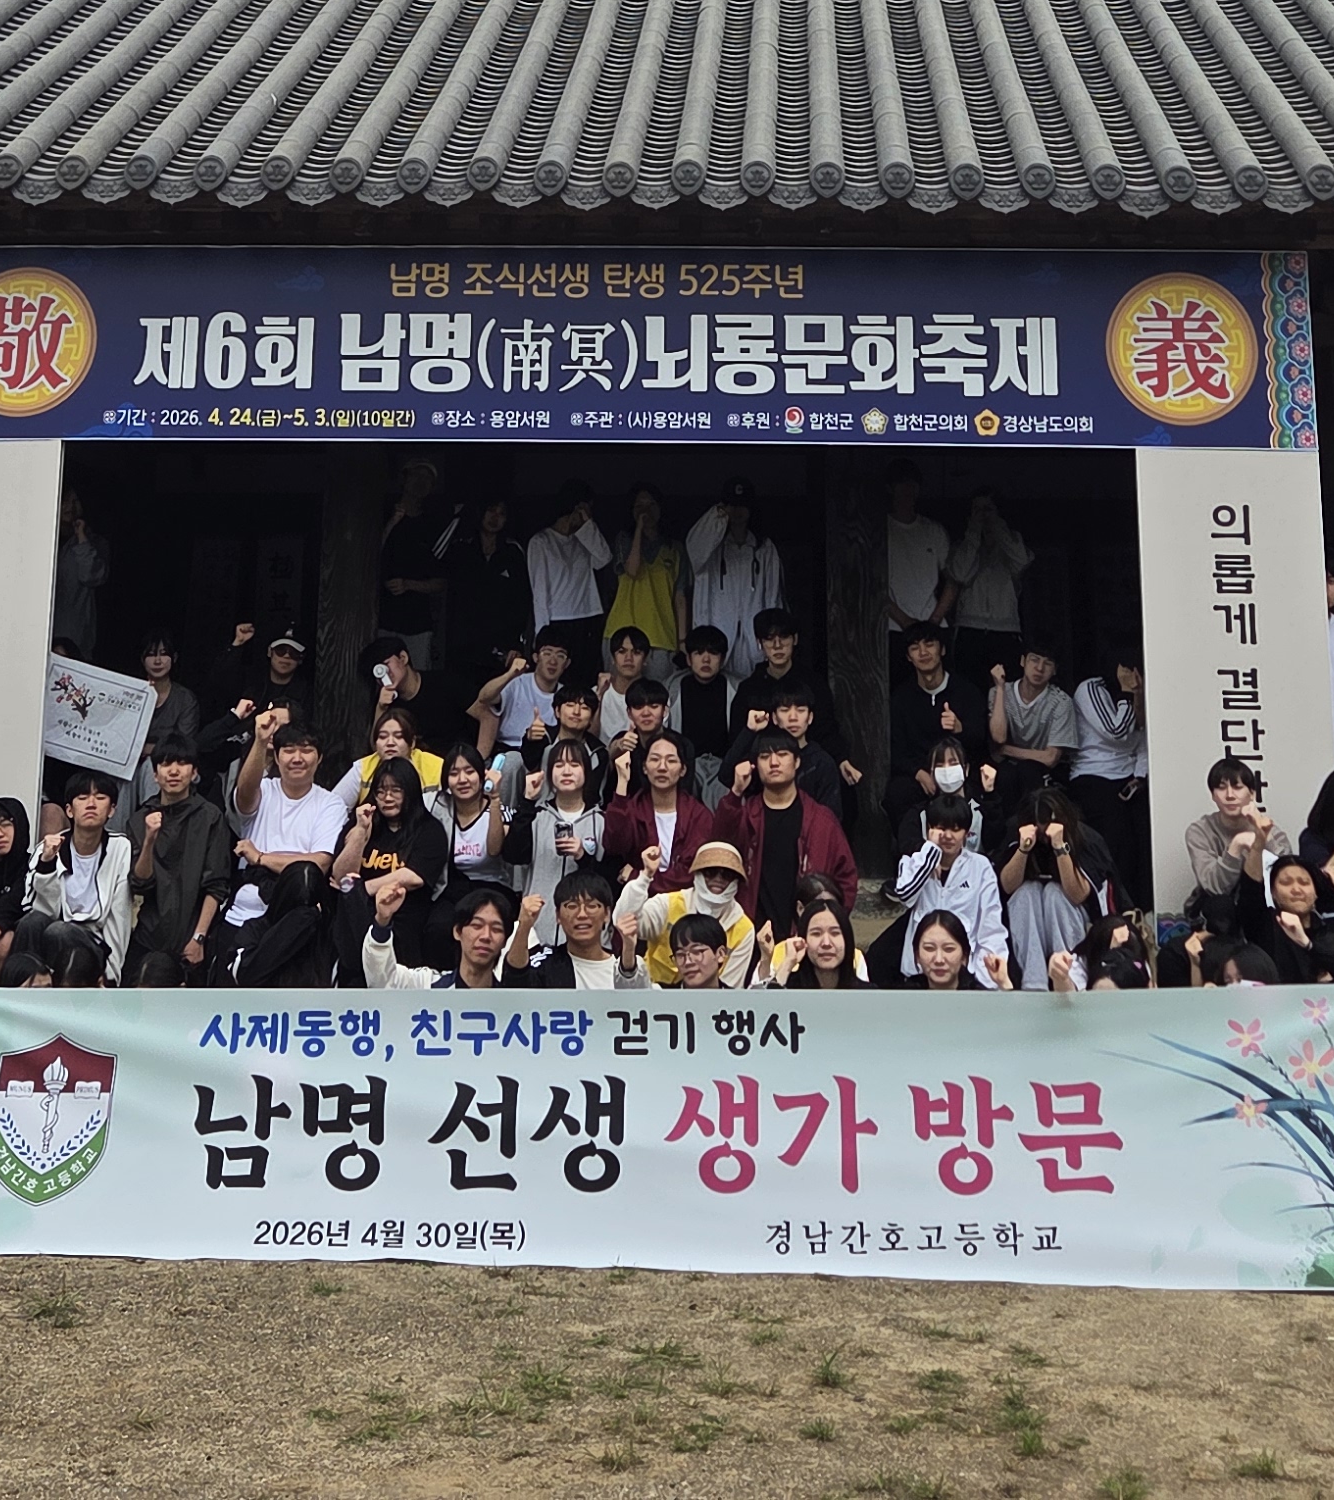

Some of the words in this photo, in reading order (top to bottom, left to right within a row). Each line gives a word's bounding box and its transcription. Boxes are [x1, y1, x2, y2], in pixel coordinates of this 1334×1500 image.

[389, 262, 450, 299] 남명
[463, 261, 591, 299] 조식선생
[603, 263, 666, 299] 탄생
[679, 264, 806, 299] 525주년
[133, 312, 315, 390] 제6회
[1131, 300, 1231, 401] 義
[116, 408, 146, 428] 기간
[160, 410, 203, 428] 2026.
[444, 409, 475, 429] 장소
[490, 409, 551, 429] 용암서원
[584, 411, 614, 430] 주관
[627, 411, 711, 431] (사)용암서원
[741, 411, 771, 431] 후원
[809, 412, 854, 431] 합천군
[893, 413, 968, 432] 합천군의회
[1003, 415, 1094, 433] 경상남도의회
[1211, 504, 1258, 646] 의롭게
[199, 1010, 394, 1061] 사제동행,
[410, 1009, 593, 1058] 친구사랑
[607, 1010, 696, 1057] 걷기
[712, 1010, 806, 1054] 행사
[193, 1074, 385, 1192] 남명
[427, 1075, 626, 1193] 선생
[663, 1074, 878, 1195] 생가
[907, 1074, 1125, 1196] 방문
[253, 1220, 352, 1250] 2026년
[361, 1219, 406, 1250] 4월
[415, 1220, 527, 1252] 30일(목)
[765, 1220, 1064, 1256] 경남간호고등학교
